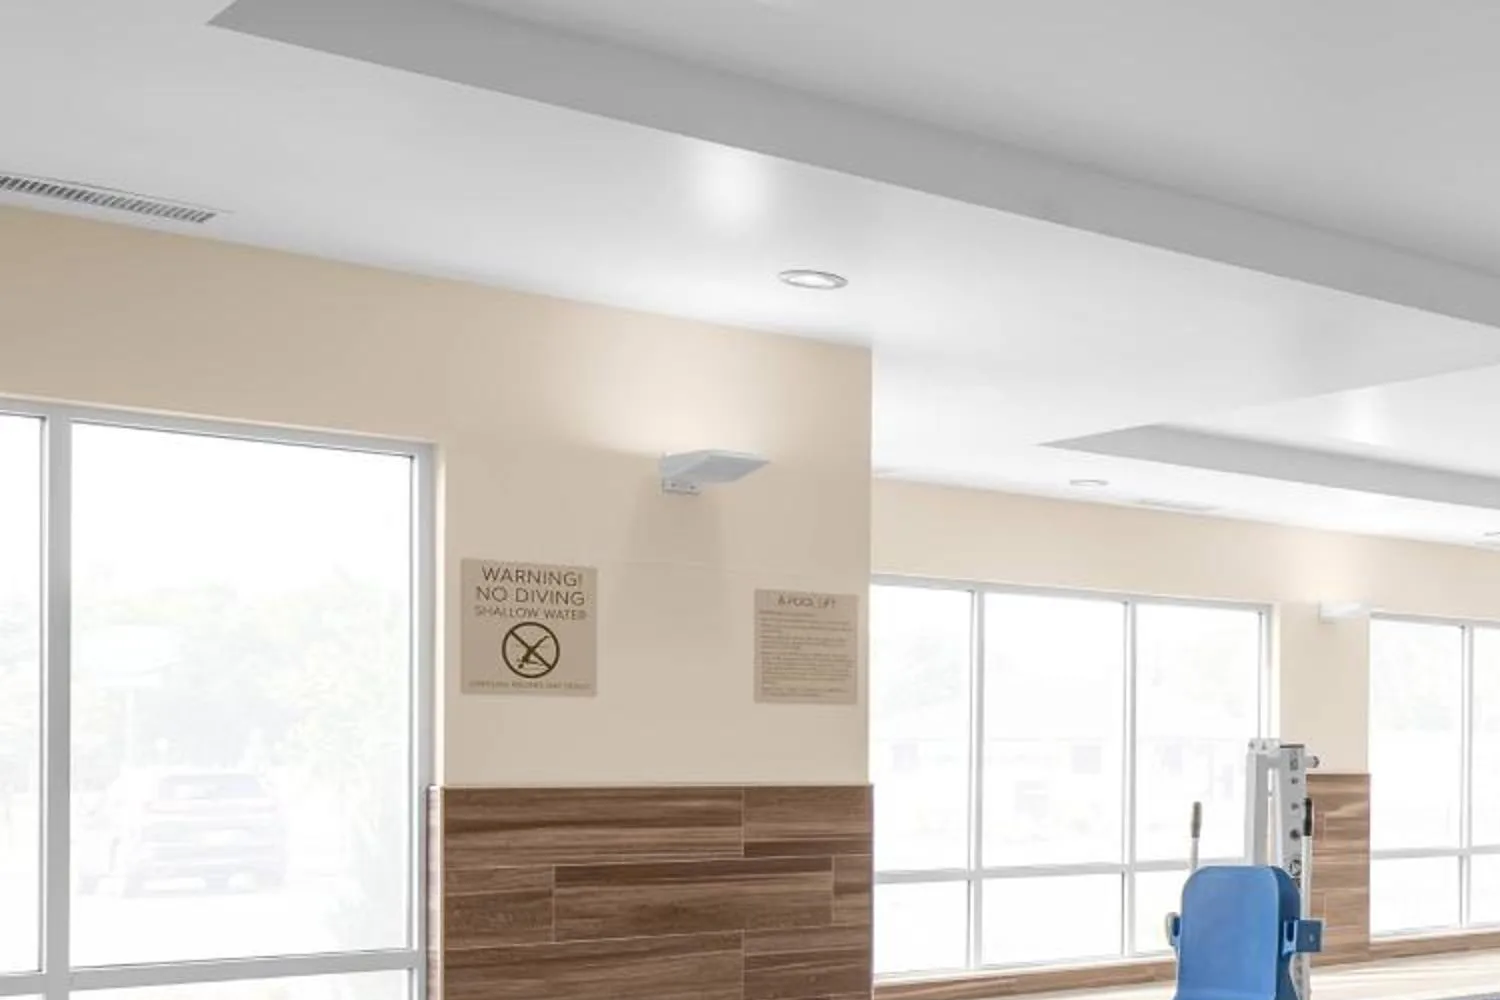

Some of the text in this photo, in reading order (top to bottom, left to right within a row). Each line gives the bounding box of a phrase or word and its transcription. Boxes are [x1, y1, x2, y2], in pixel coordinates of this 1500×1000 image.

[482, 567, 583, 587] WARNING!
[476, 585, 585, 606] NO DIVING
[474, 605, 587, 620] SHALLOW WATER
